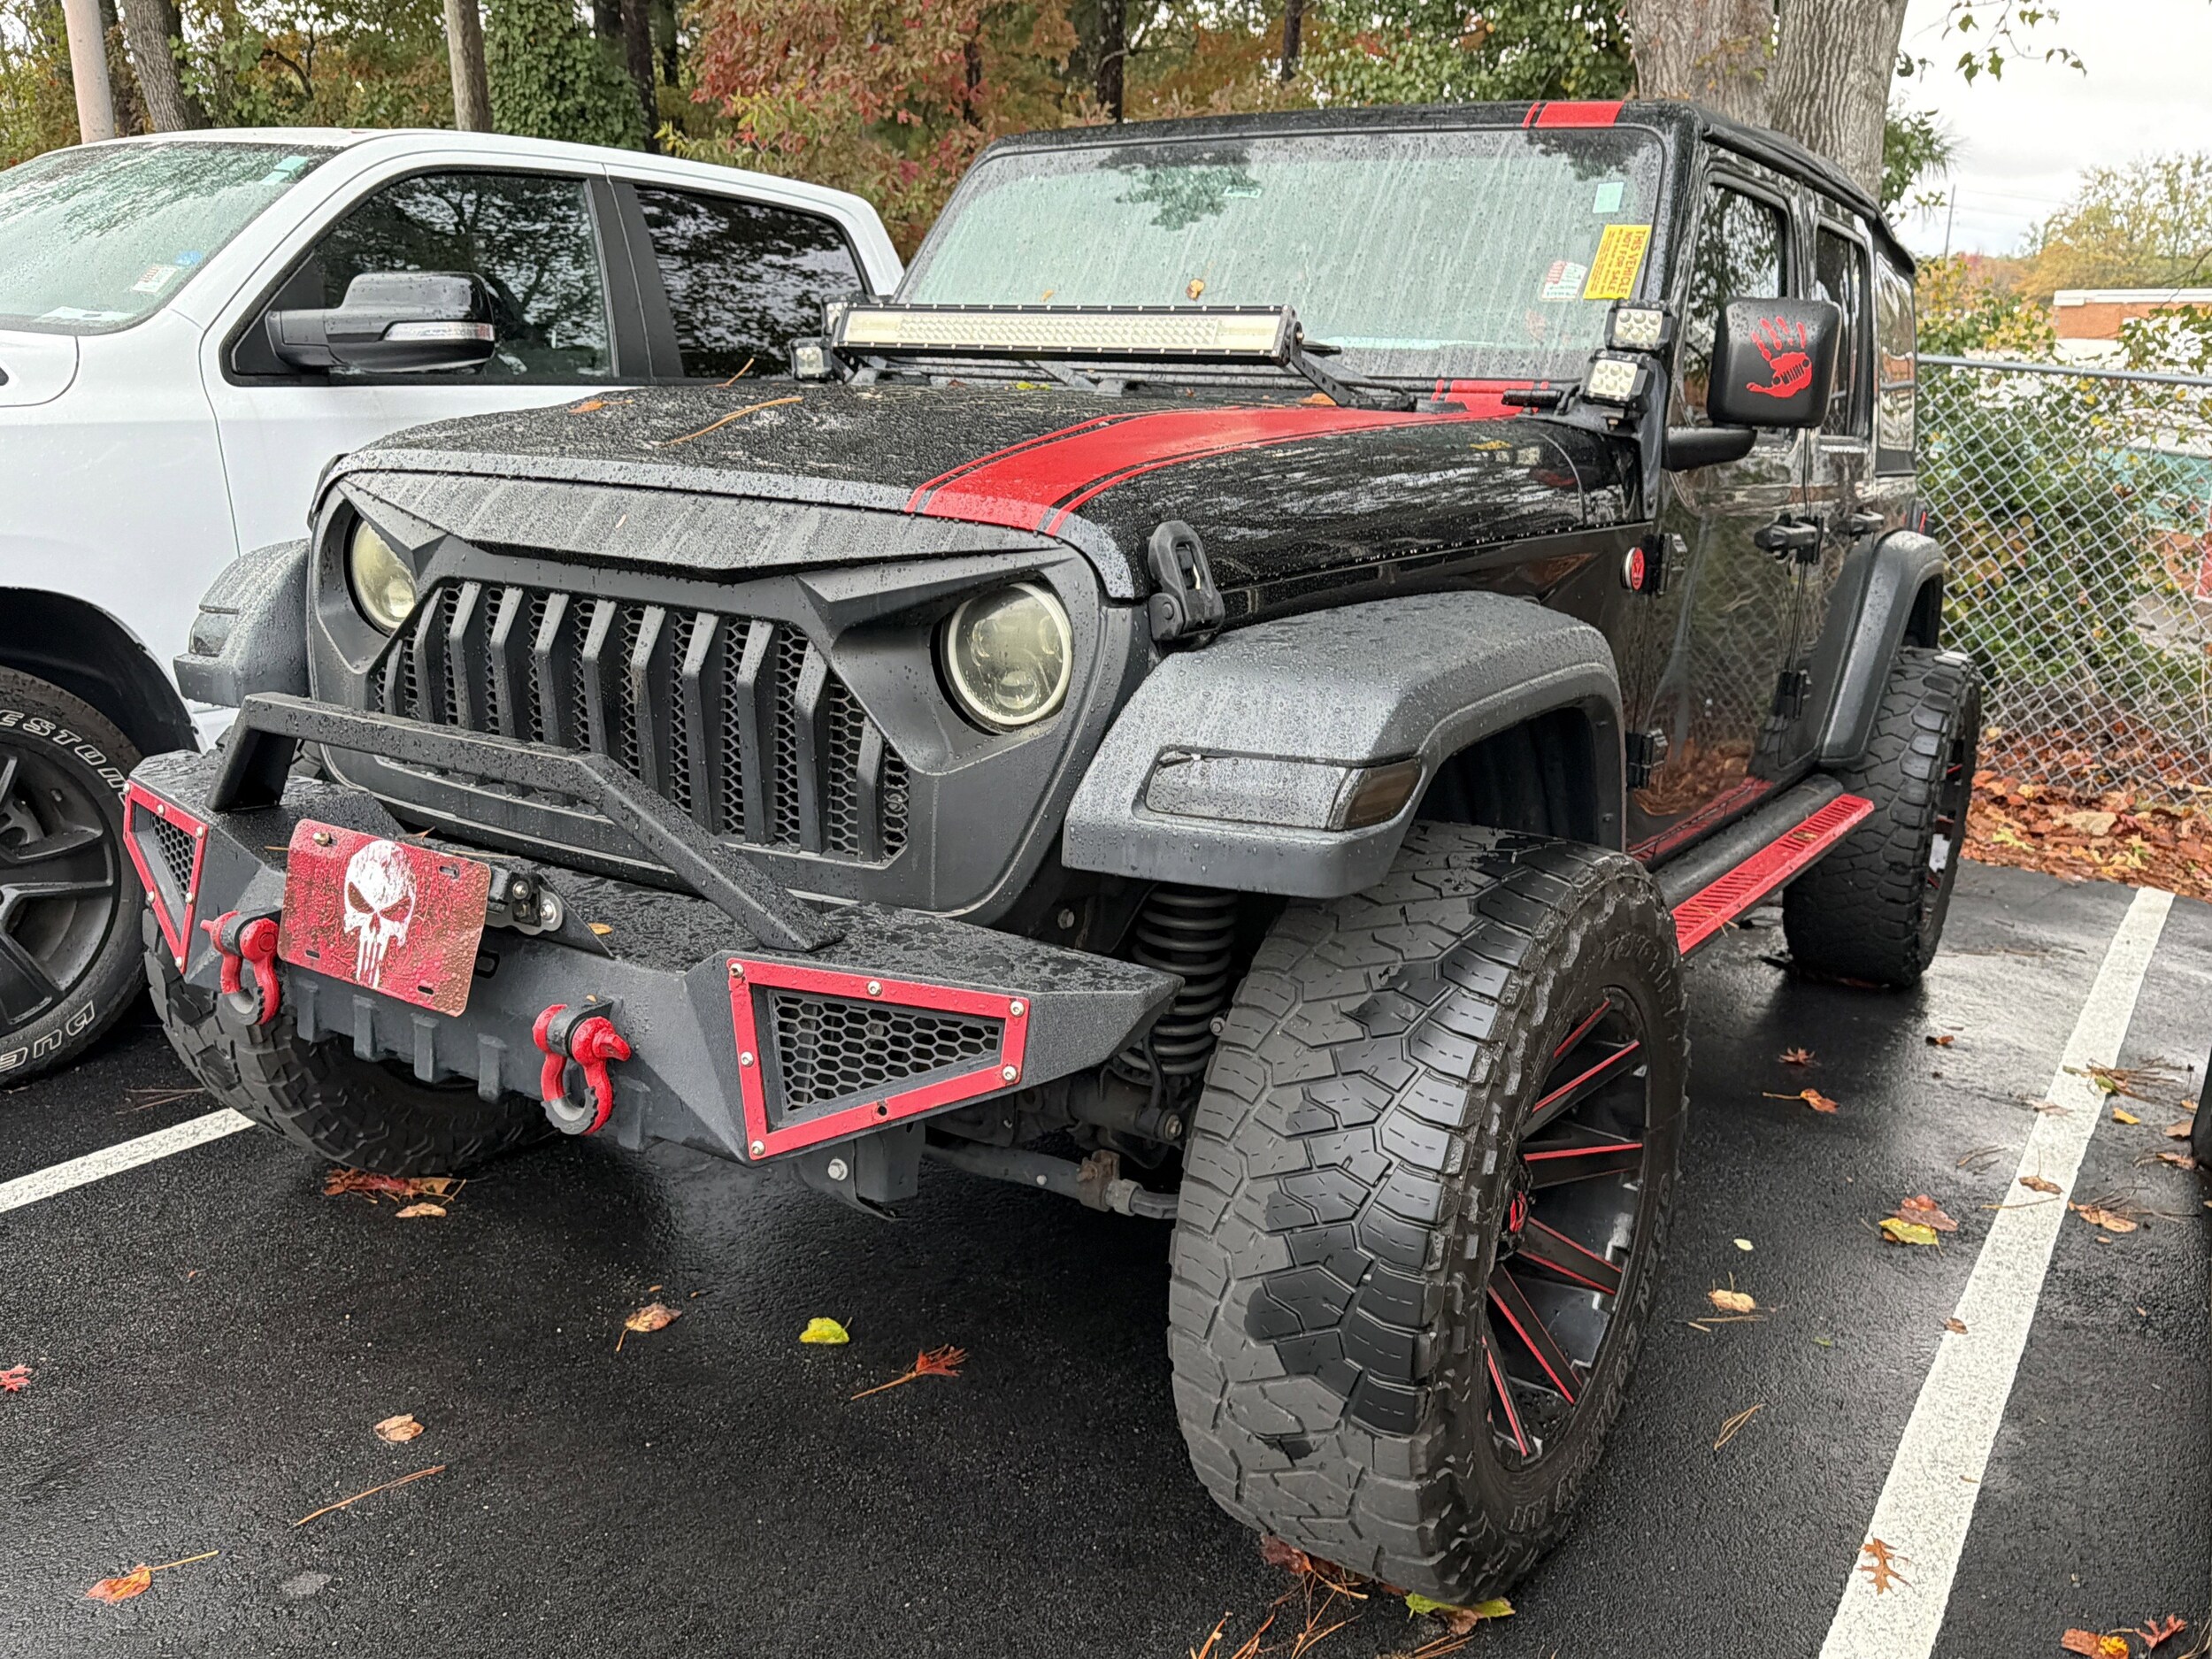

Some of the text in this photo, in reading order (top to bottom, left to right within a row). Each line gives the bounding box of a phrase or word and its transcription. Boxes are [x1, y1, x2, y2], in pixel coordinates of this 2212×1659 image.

[1622, 231, 1632, 248] NOT
[1616, 250, 1627, 267] FOR
[1617, 230, 1647, 294] THIS VEHICLE
[1607, 270, 1620, 292] SALE
[0, 710, 127, 807] ESTON
